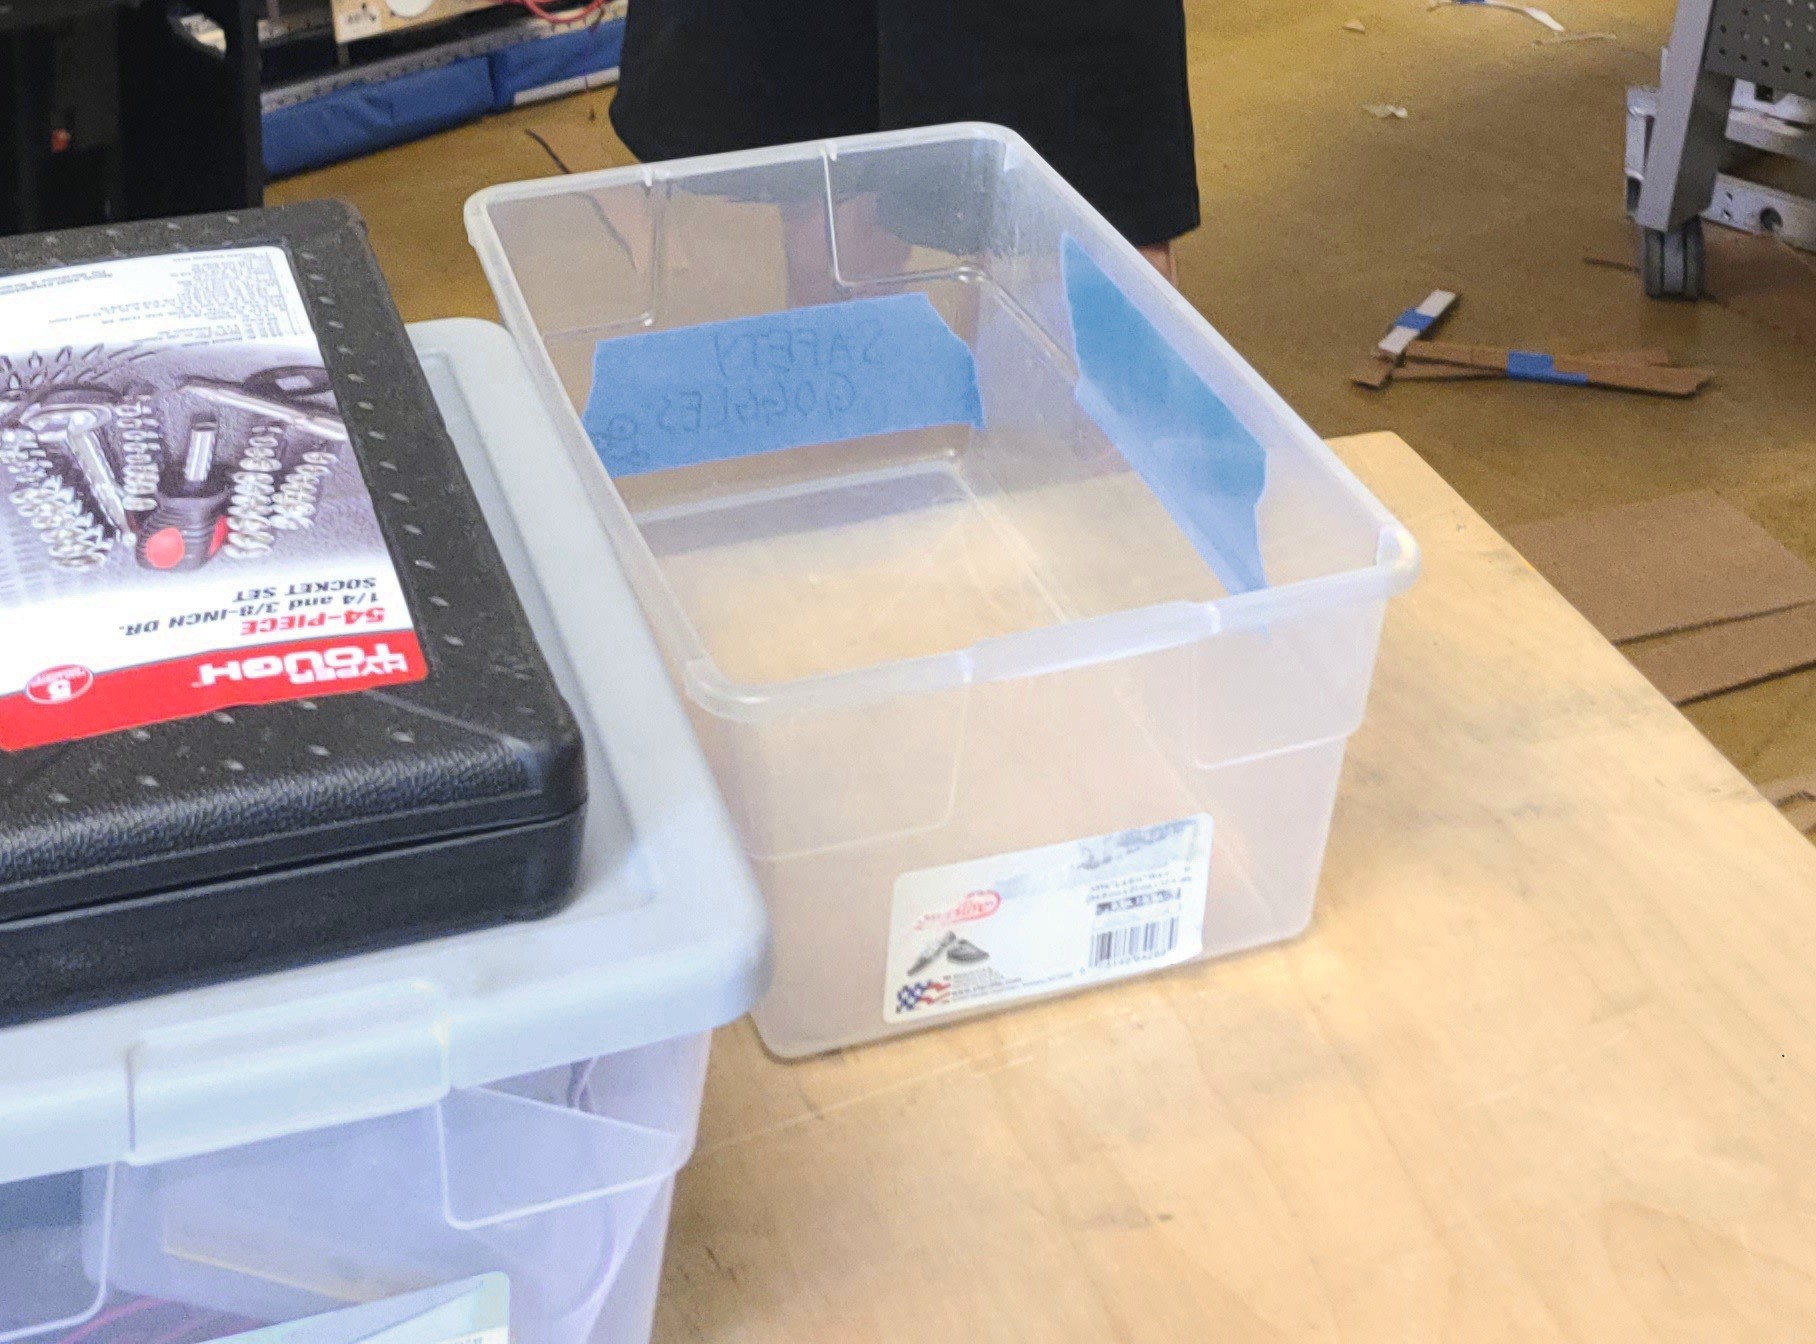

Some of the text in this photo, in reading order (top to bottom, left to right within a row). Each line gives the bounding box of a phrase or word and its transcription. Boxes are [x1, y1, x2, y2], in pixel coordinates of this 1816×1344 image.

[232, 577, 377, 603] SOCKET SET
[288, 596, 333, 611] and
[343, 592, 379, 605] 1/4
[169, 601, 280, 629] 3/8-INCH
[240, 607, 385, 636] 54-PIECE
[199, 643, 404, 686] TOUGH
